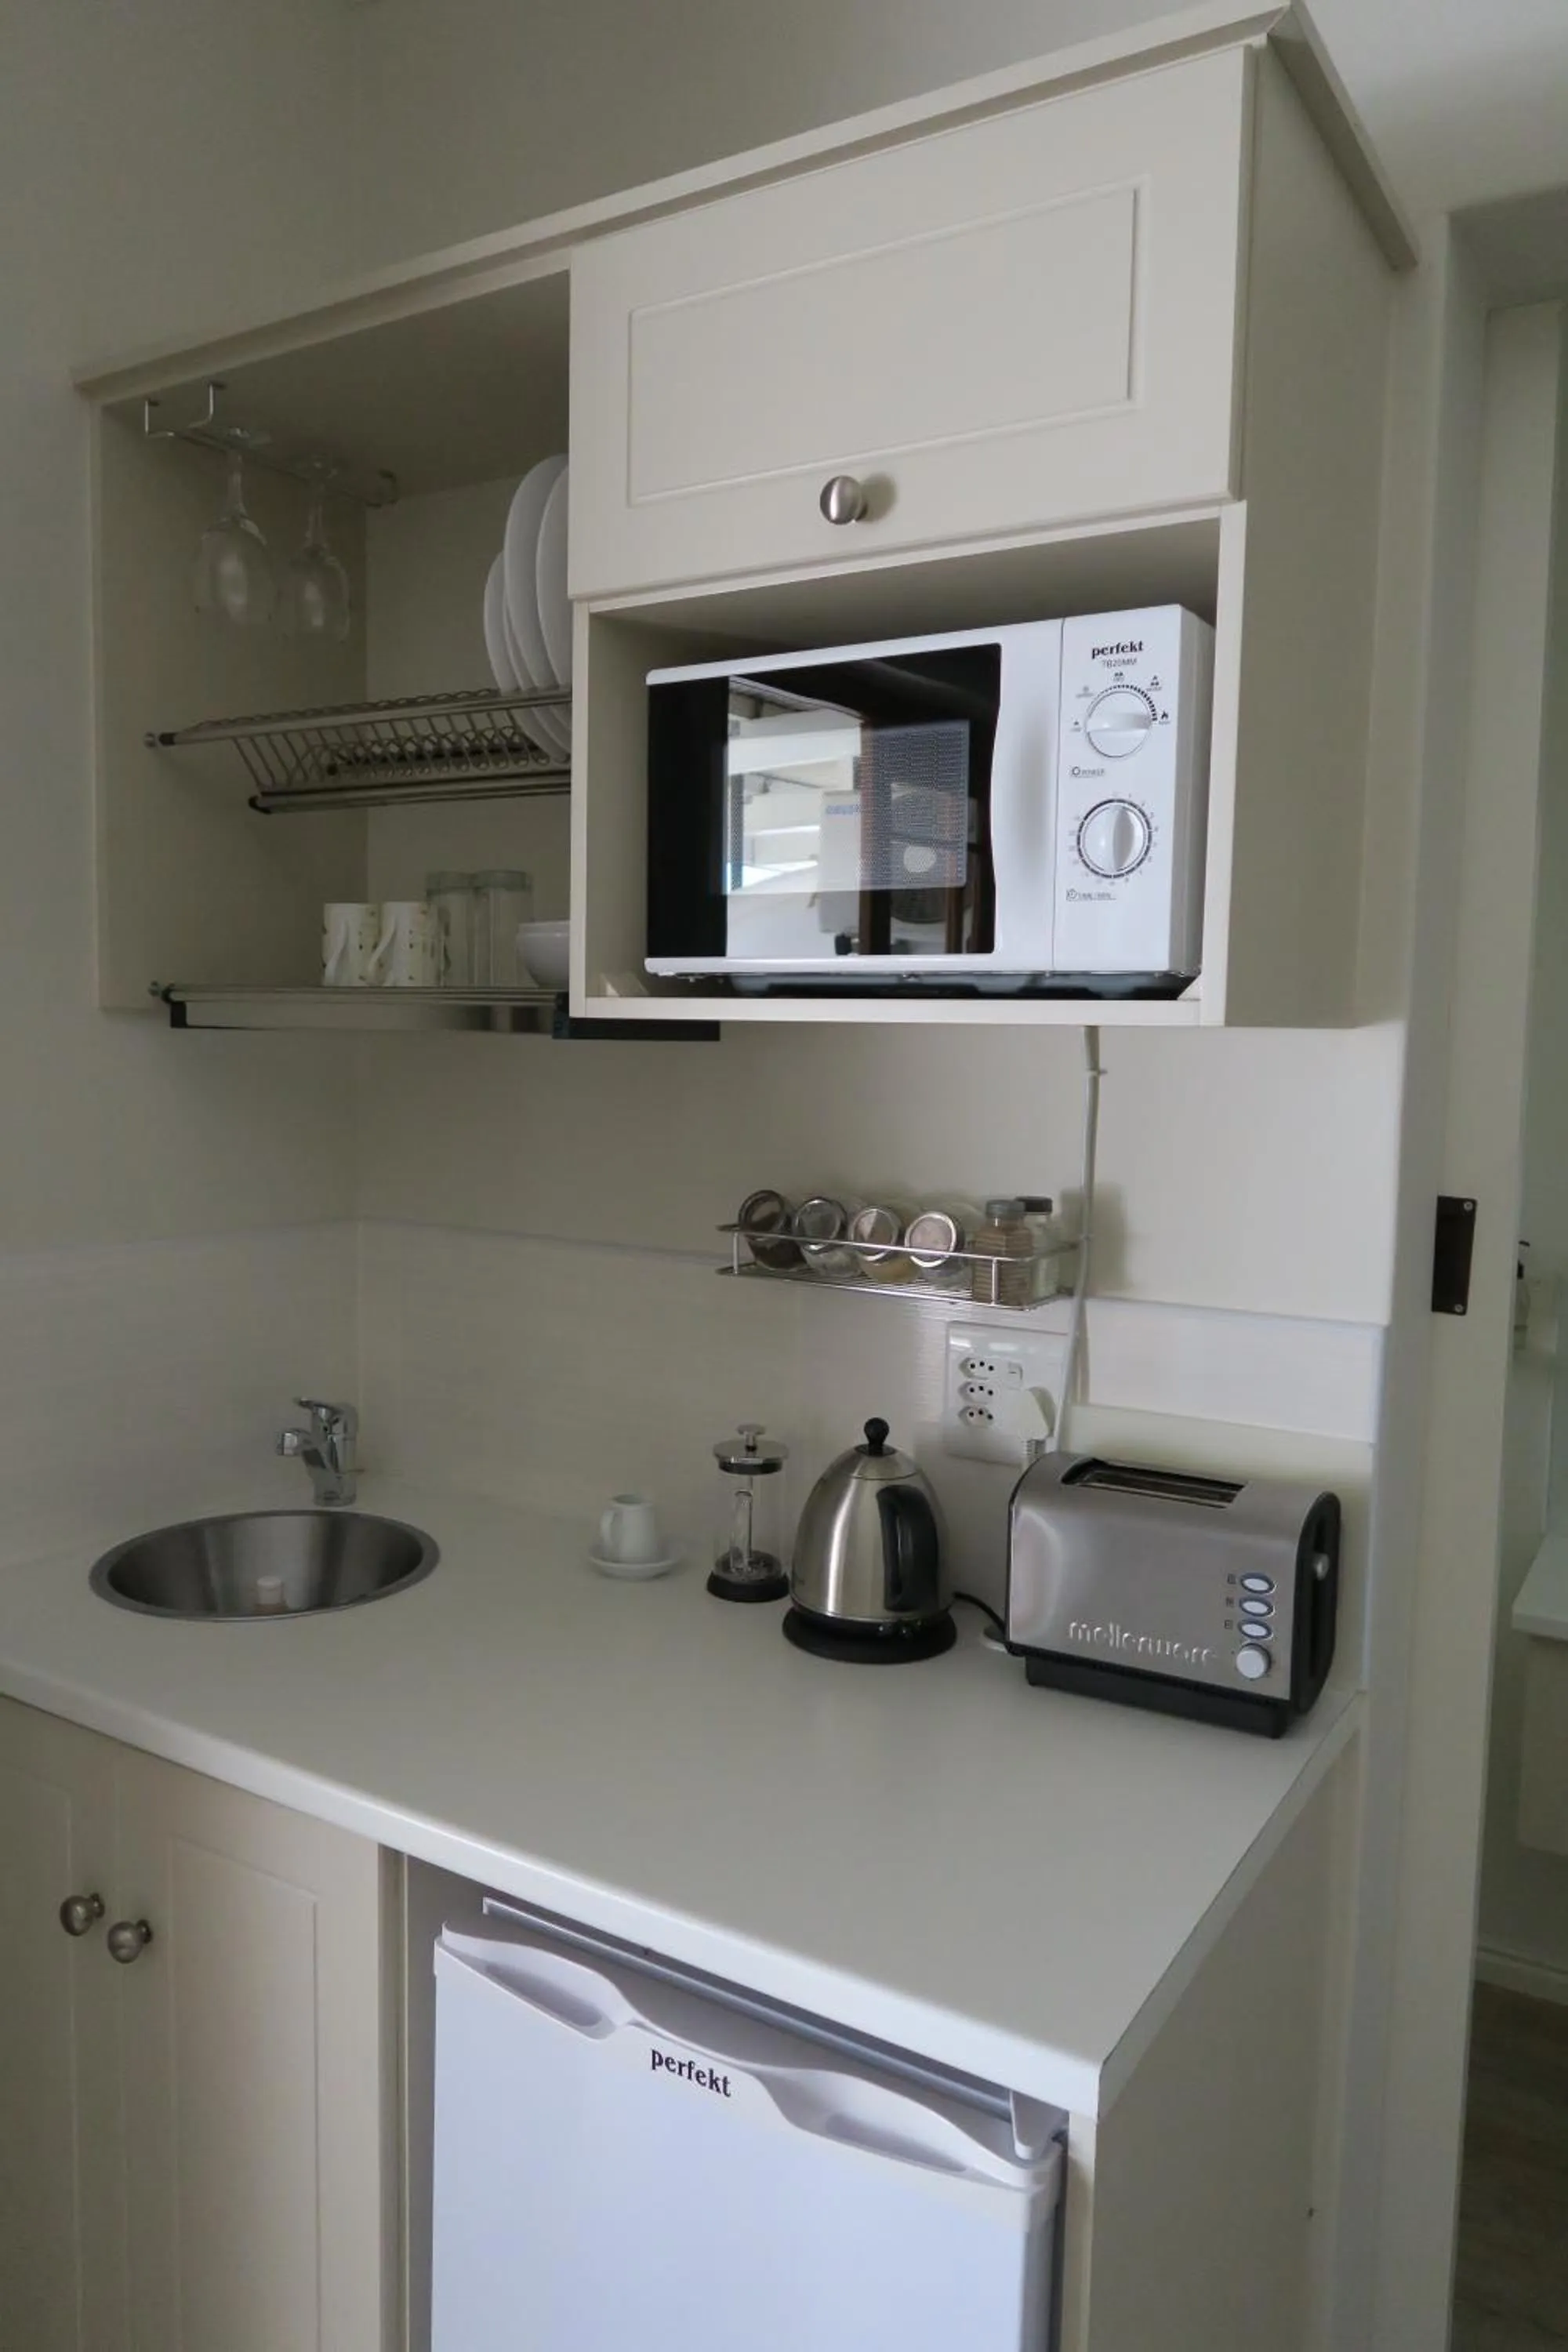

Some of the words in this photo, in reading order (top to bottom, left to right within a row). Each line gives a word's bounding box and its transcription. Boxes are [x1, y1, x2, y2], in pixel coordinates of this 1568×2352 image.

[1091, 641, 1143, 659] perfekt
[1069, 1621, 1218, 1664] mellerware
[651, 2049, 731, 2097] perfekt
